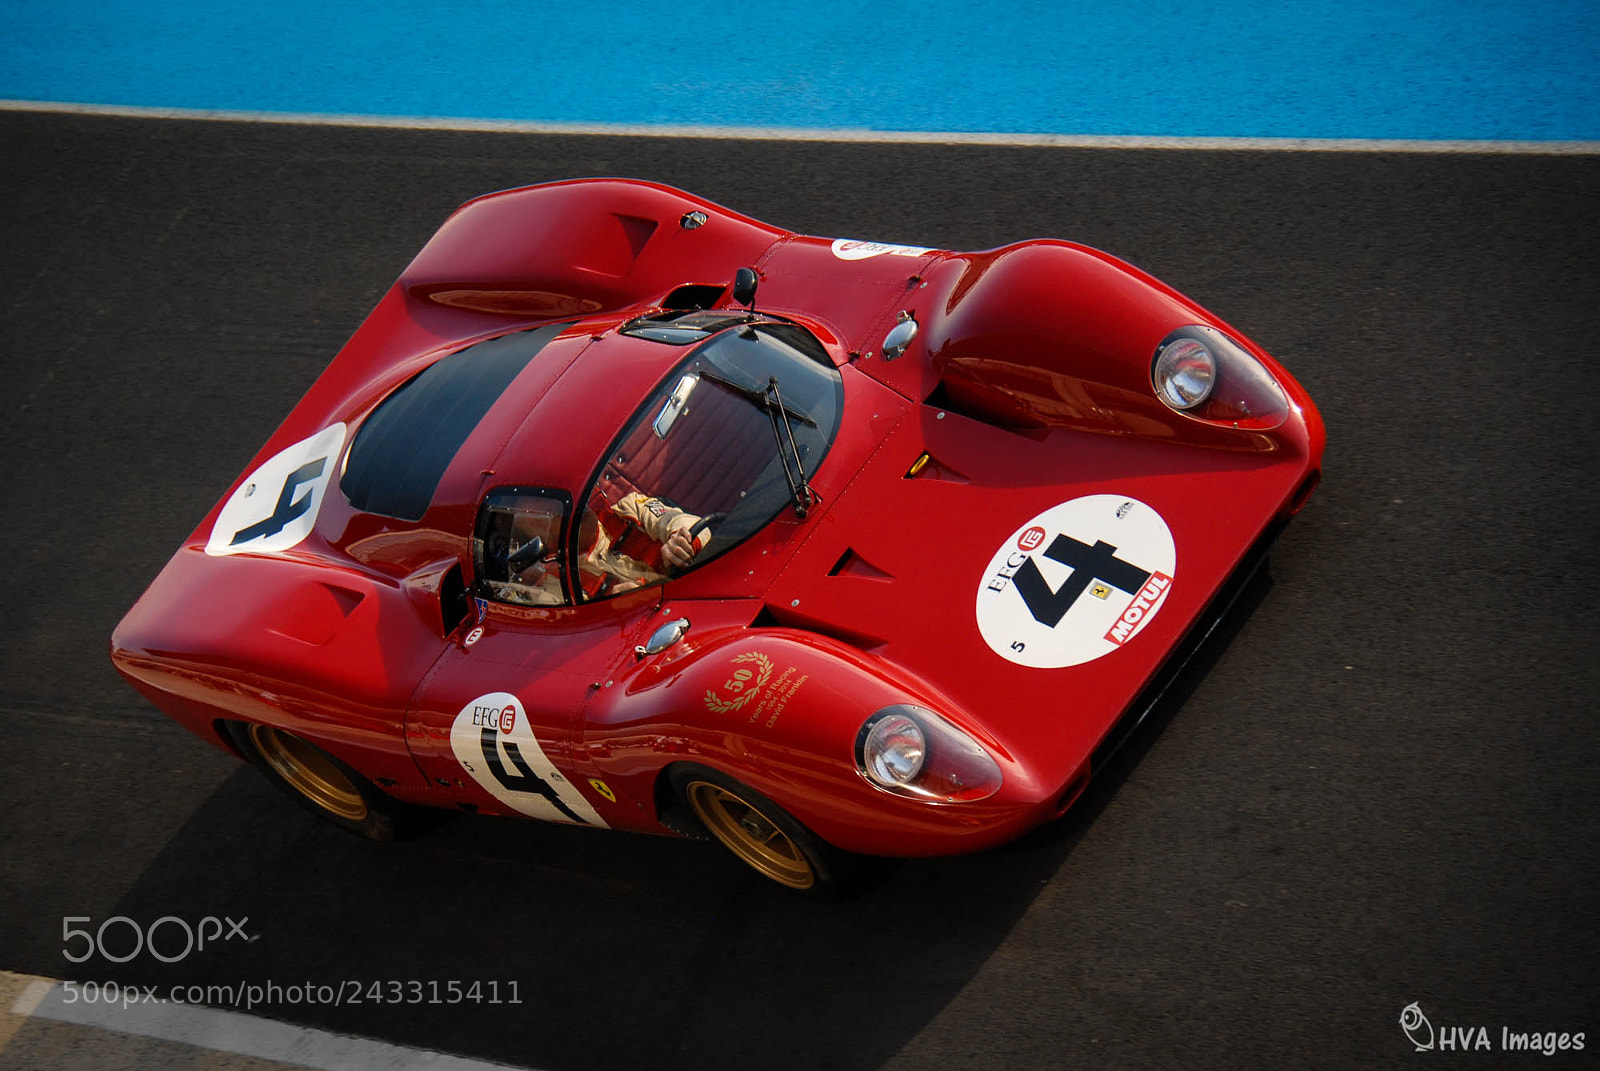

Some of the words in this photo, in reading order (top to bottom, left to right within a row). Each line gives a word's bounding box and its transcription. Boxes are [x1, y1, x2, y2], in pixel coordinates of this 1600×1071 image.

[228, 456, 328, 546] 4
[988, 551, 1027, 594] EFG
[1012, 533, 1152, 628] 4
[1110, 575, 1171, 643] MOTUL
[467, 630, 480, 642] E
[1010, 641, 1025, 653] 5
[724, 668, 753, 693] 50
[749, 700, 767, 724] Years
[765, 689, 773, 699] of
[771, 666, 797, 691] Racing
[765, 703, 785, 729] David
[781, 674, 809, 704] Franklin
[472, 706, 500, 728] EFG
[462, 760, 475, 773] 5
[481, 728, 592, 824] 4
